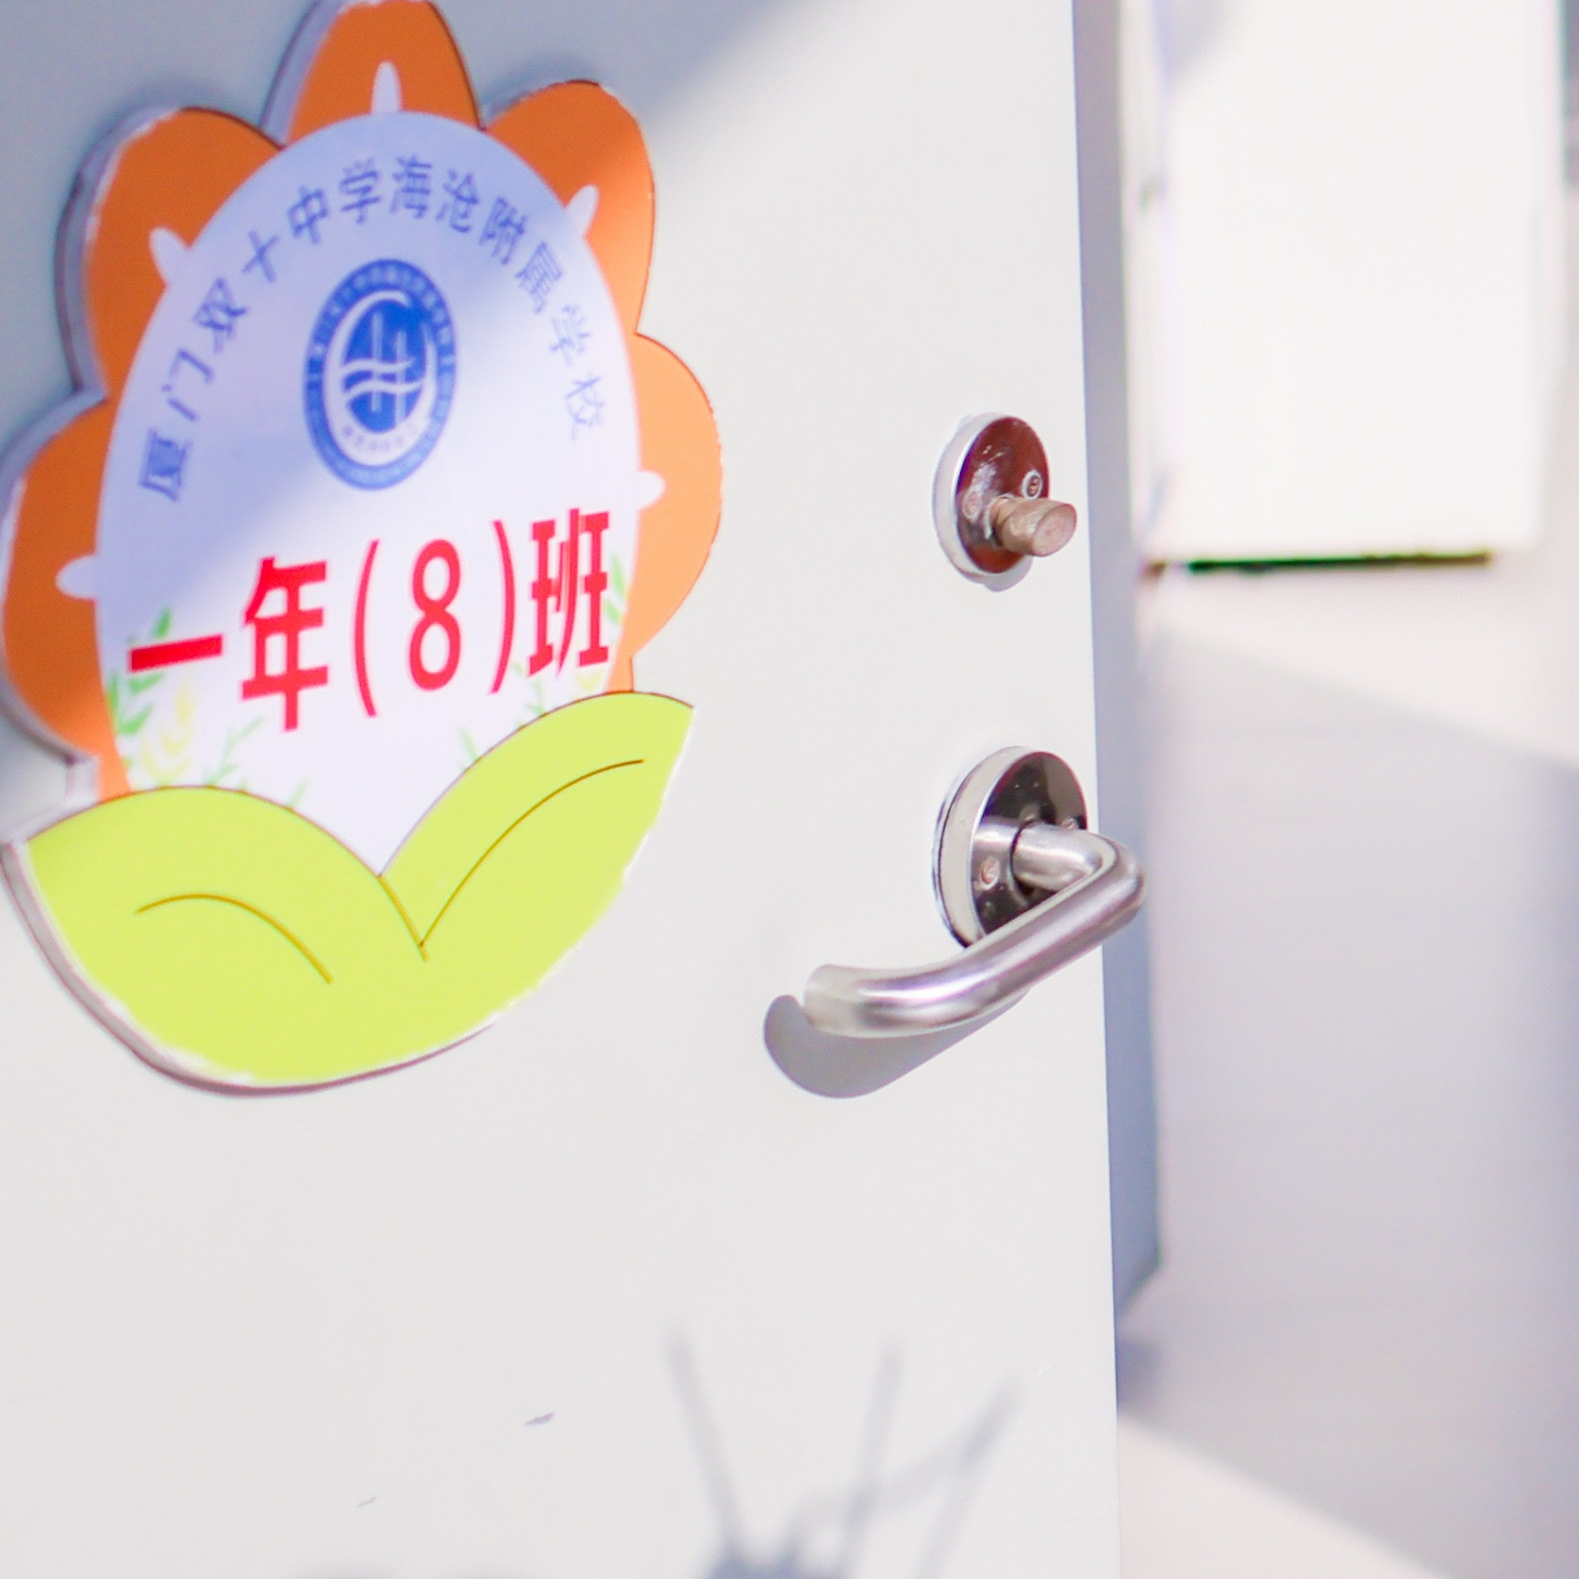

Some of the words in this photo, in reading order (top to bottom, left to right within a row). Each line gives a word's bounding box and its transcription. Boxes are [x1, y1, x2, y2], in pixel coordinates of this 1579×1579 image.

[138, 154, 604, 502] 厦门双十中学海沧附属学校
[127, 507, 610, 732] 一年(8)班
